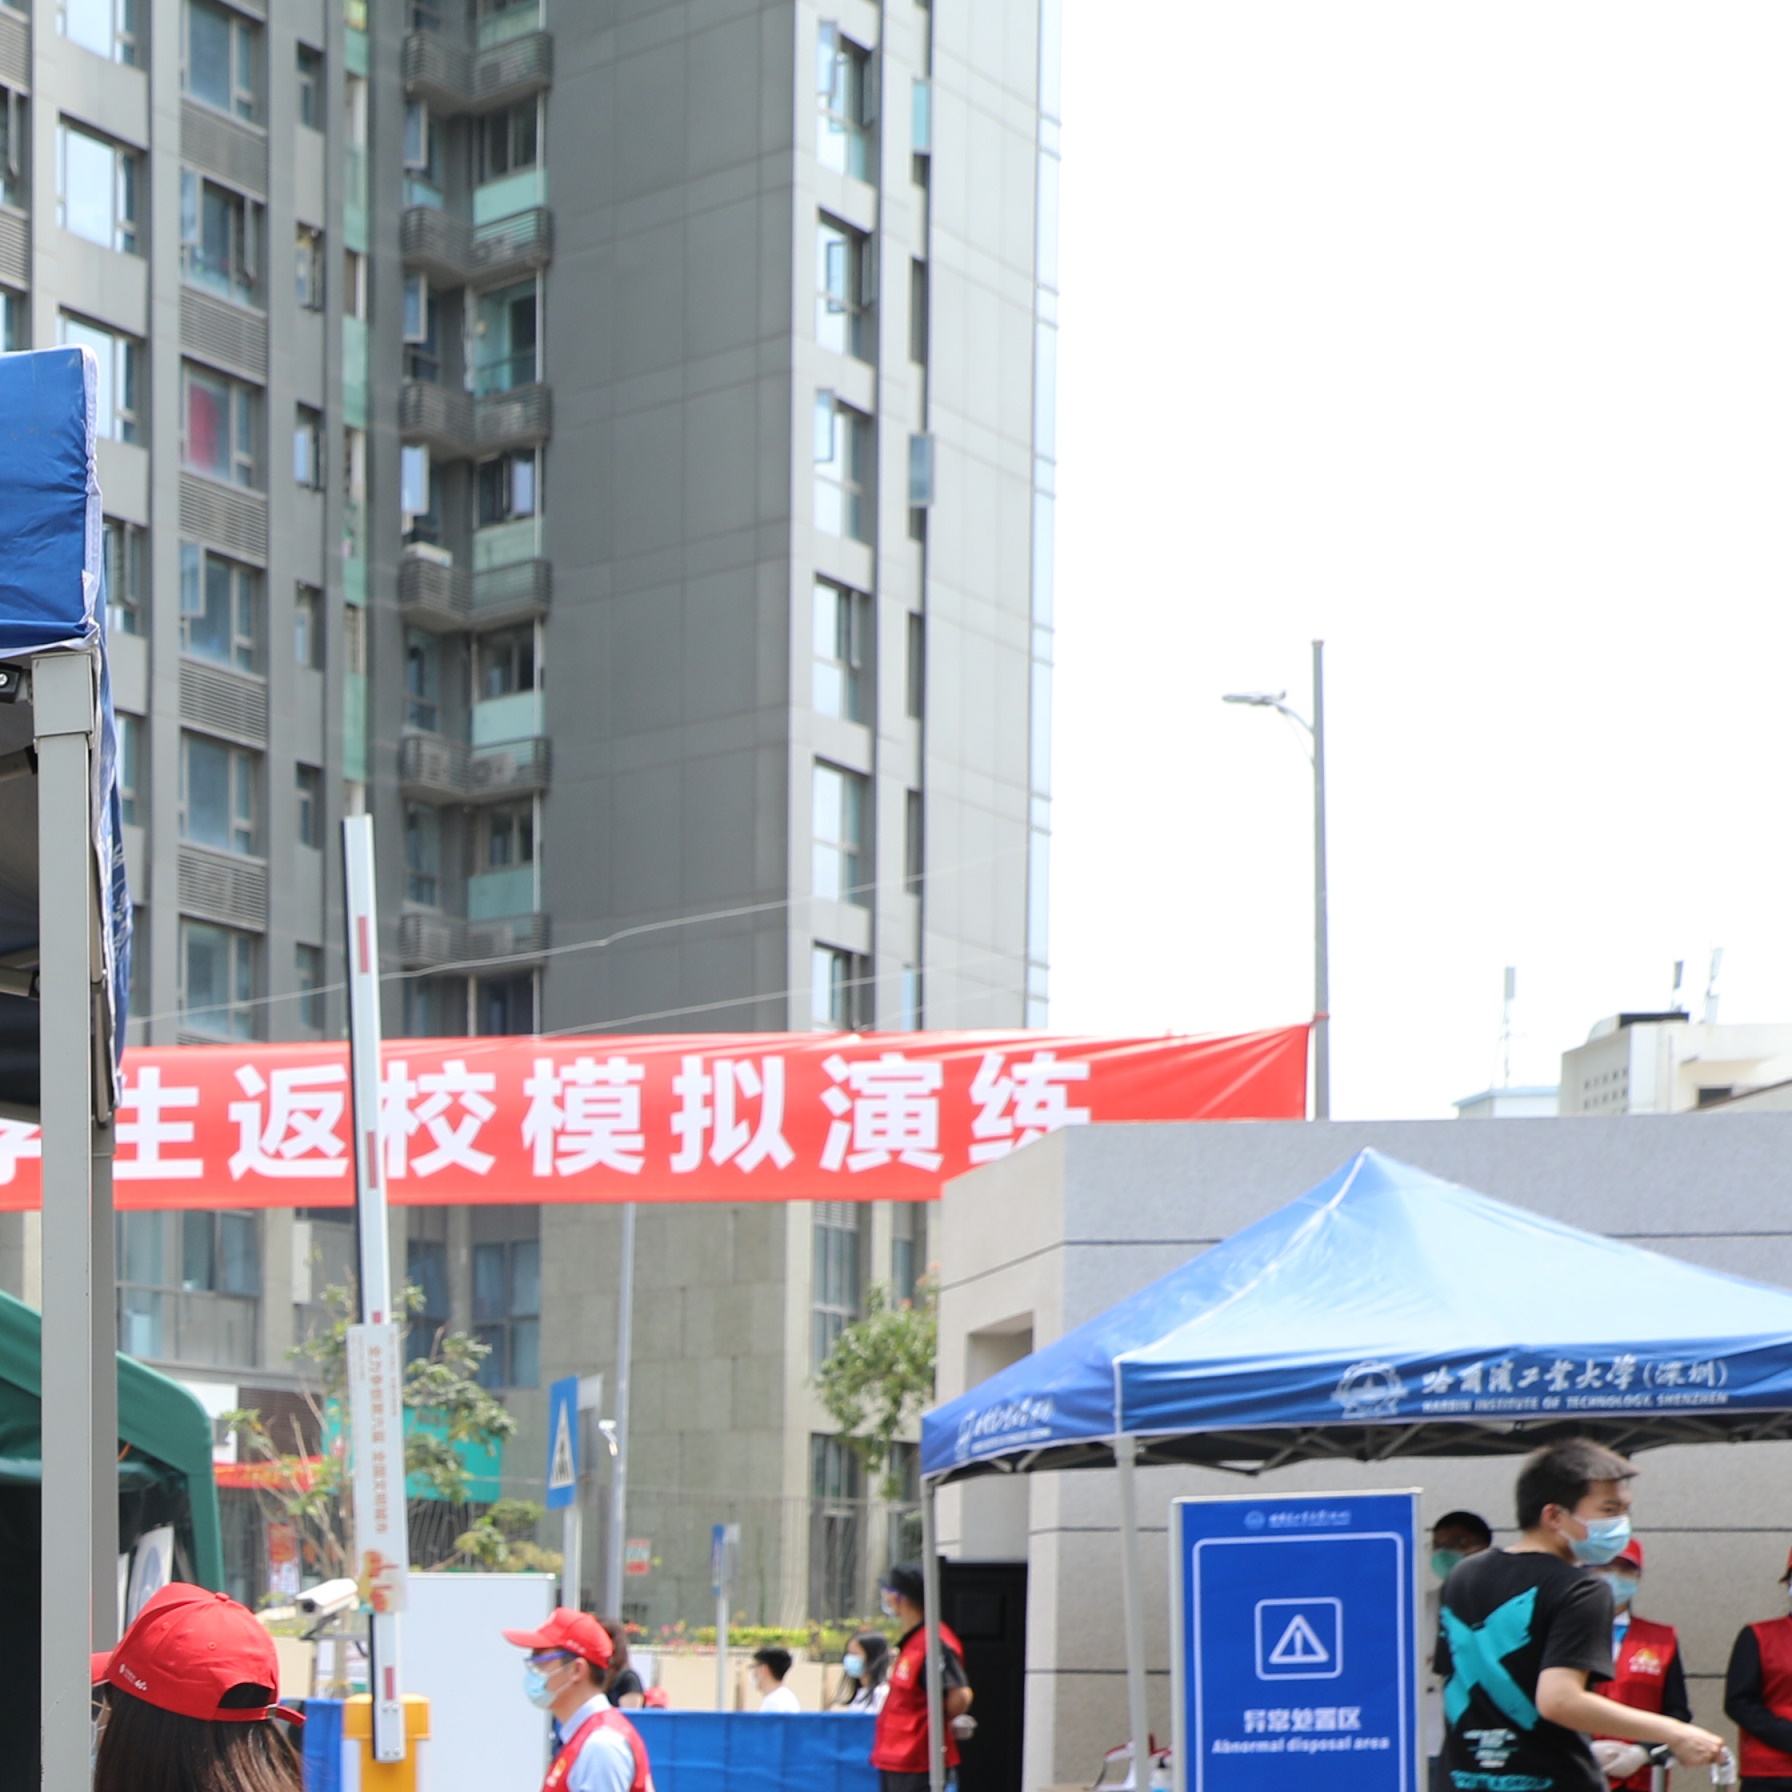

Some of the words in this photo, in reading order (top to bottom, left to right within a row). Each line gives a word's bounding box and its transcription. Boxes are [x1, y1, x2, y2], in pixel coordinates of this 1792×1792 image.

[1212, 1737, 1285, 1754] Abnormal
[1287, 1735, 1351, 1754] disposal
[1354, 1737, 1390, 1750] area
